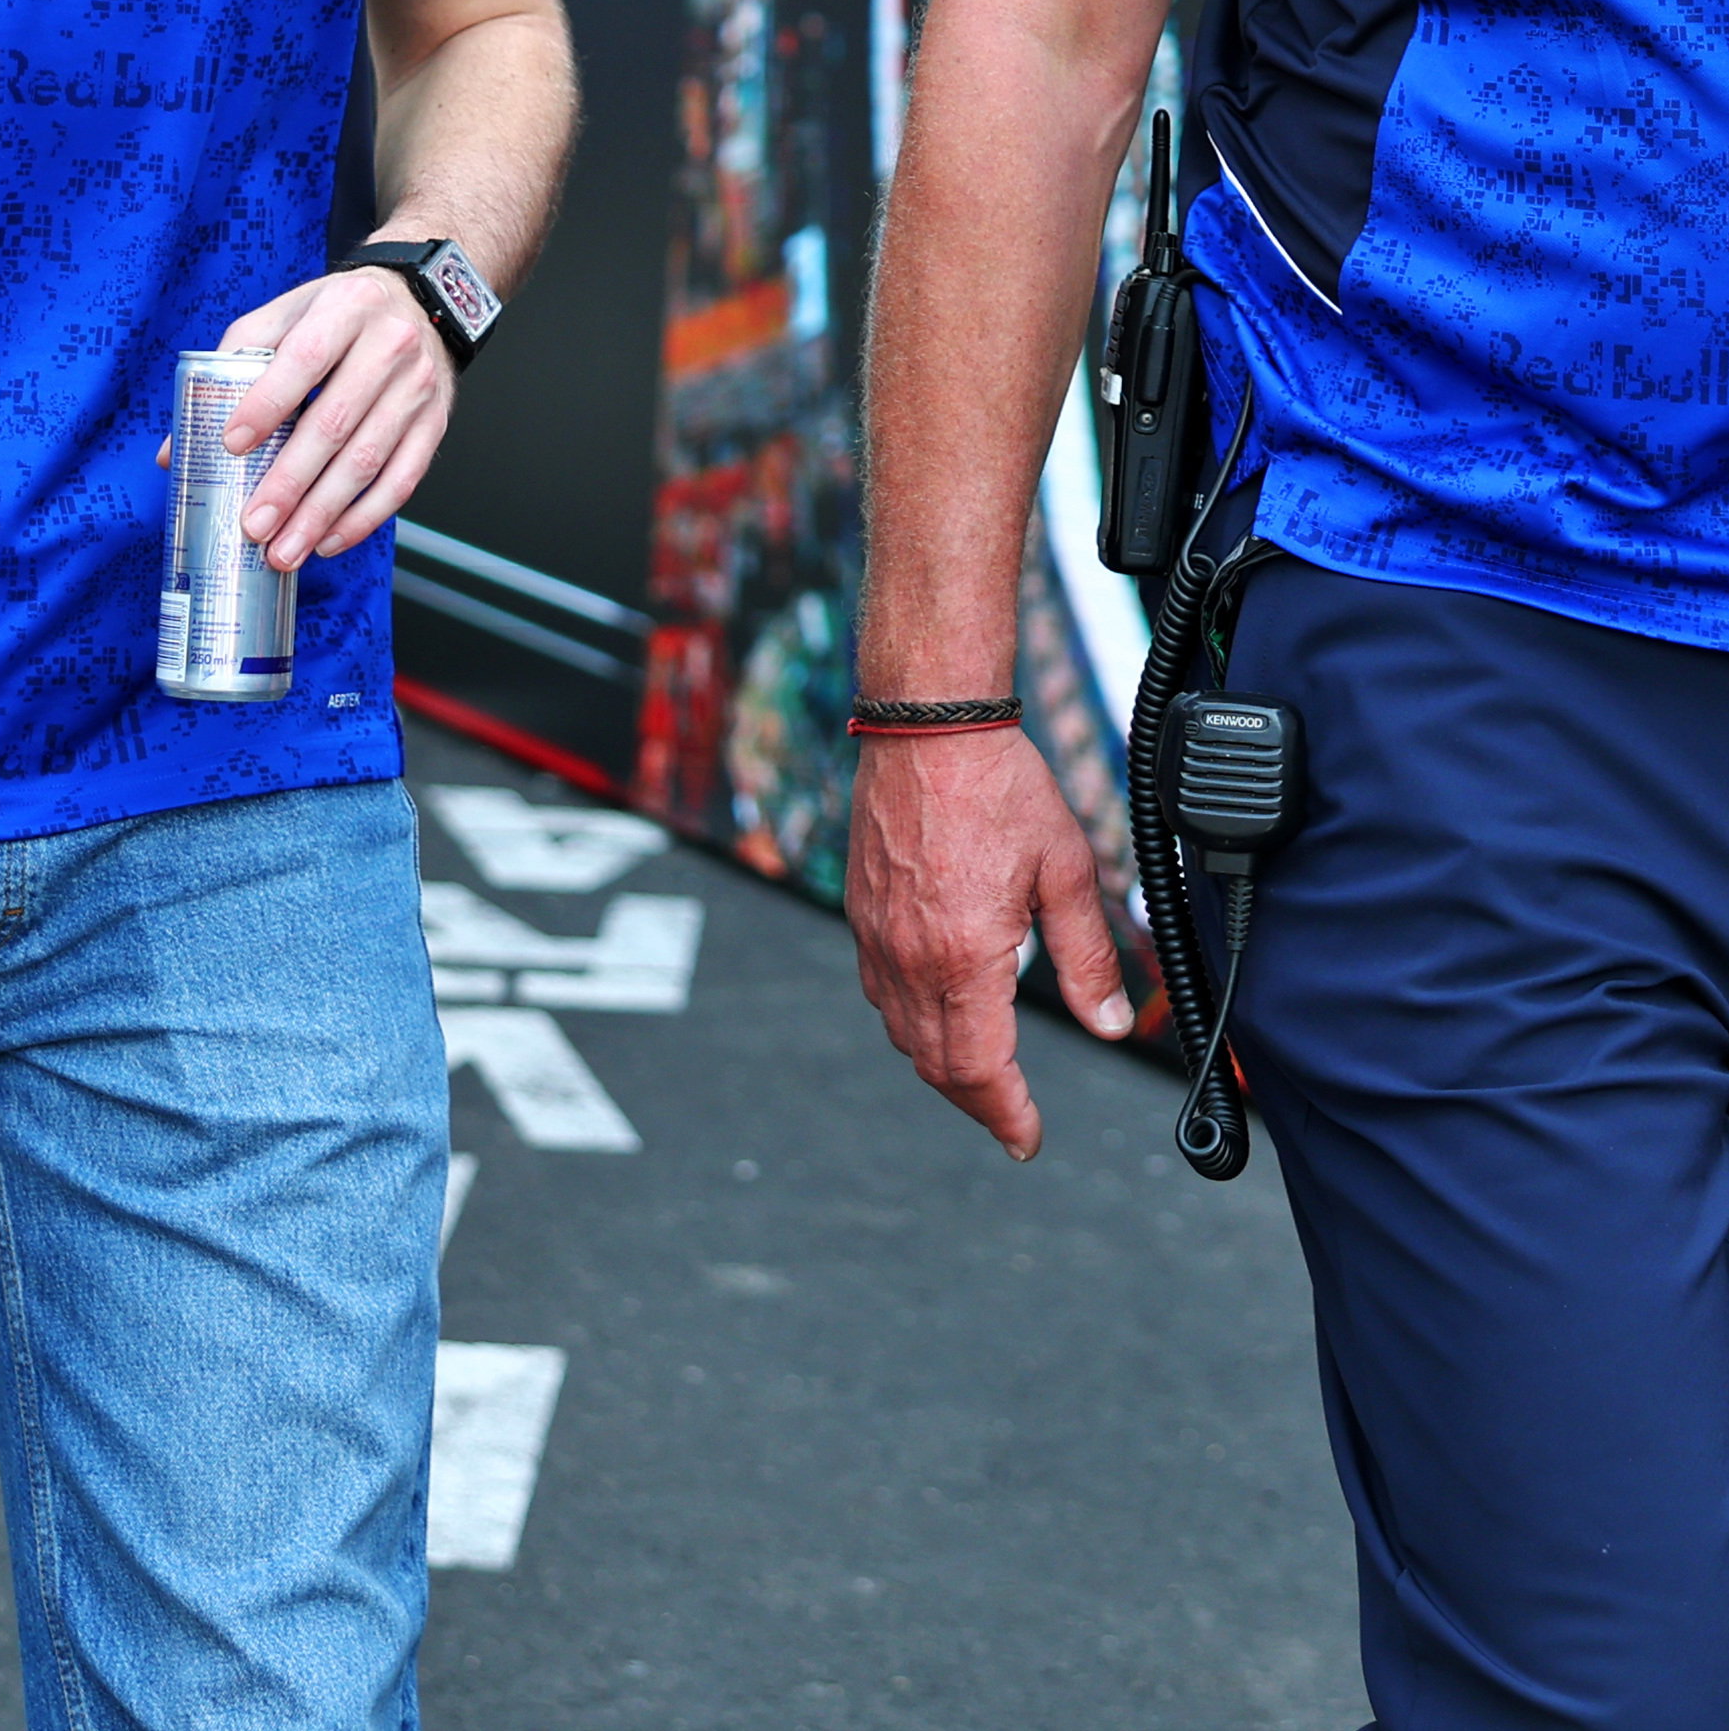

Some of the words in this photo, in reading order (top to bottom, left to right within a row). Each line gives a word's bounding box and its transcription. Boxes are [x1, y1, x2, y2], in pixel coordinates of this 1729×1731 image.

[190, 653, 212, 665] 250
[213, 653, 228, 665] ml
[1205, 713, 1263, 729] KENWOOD
